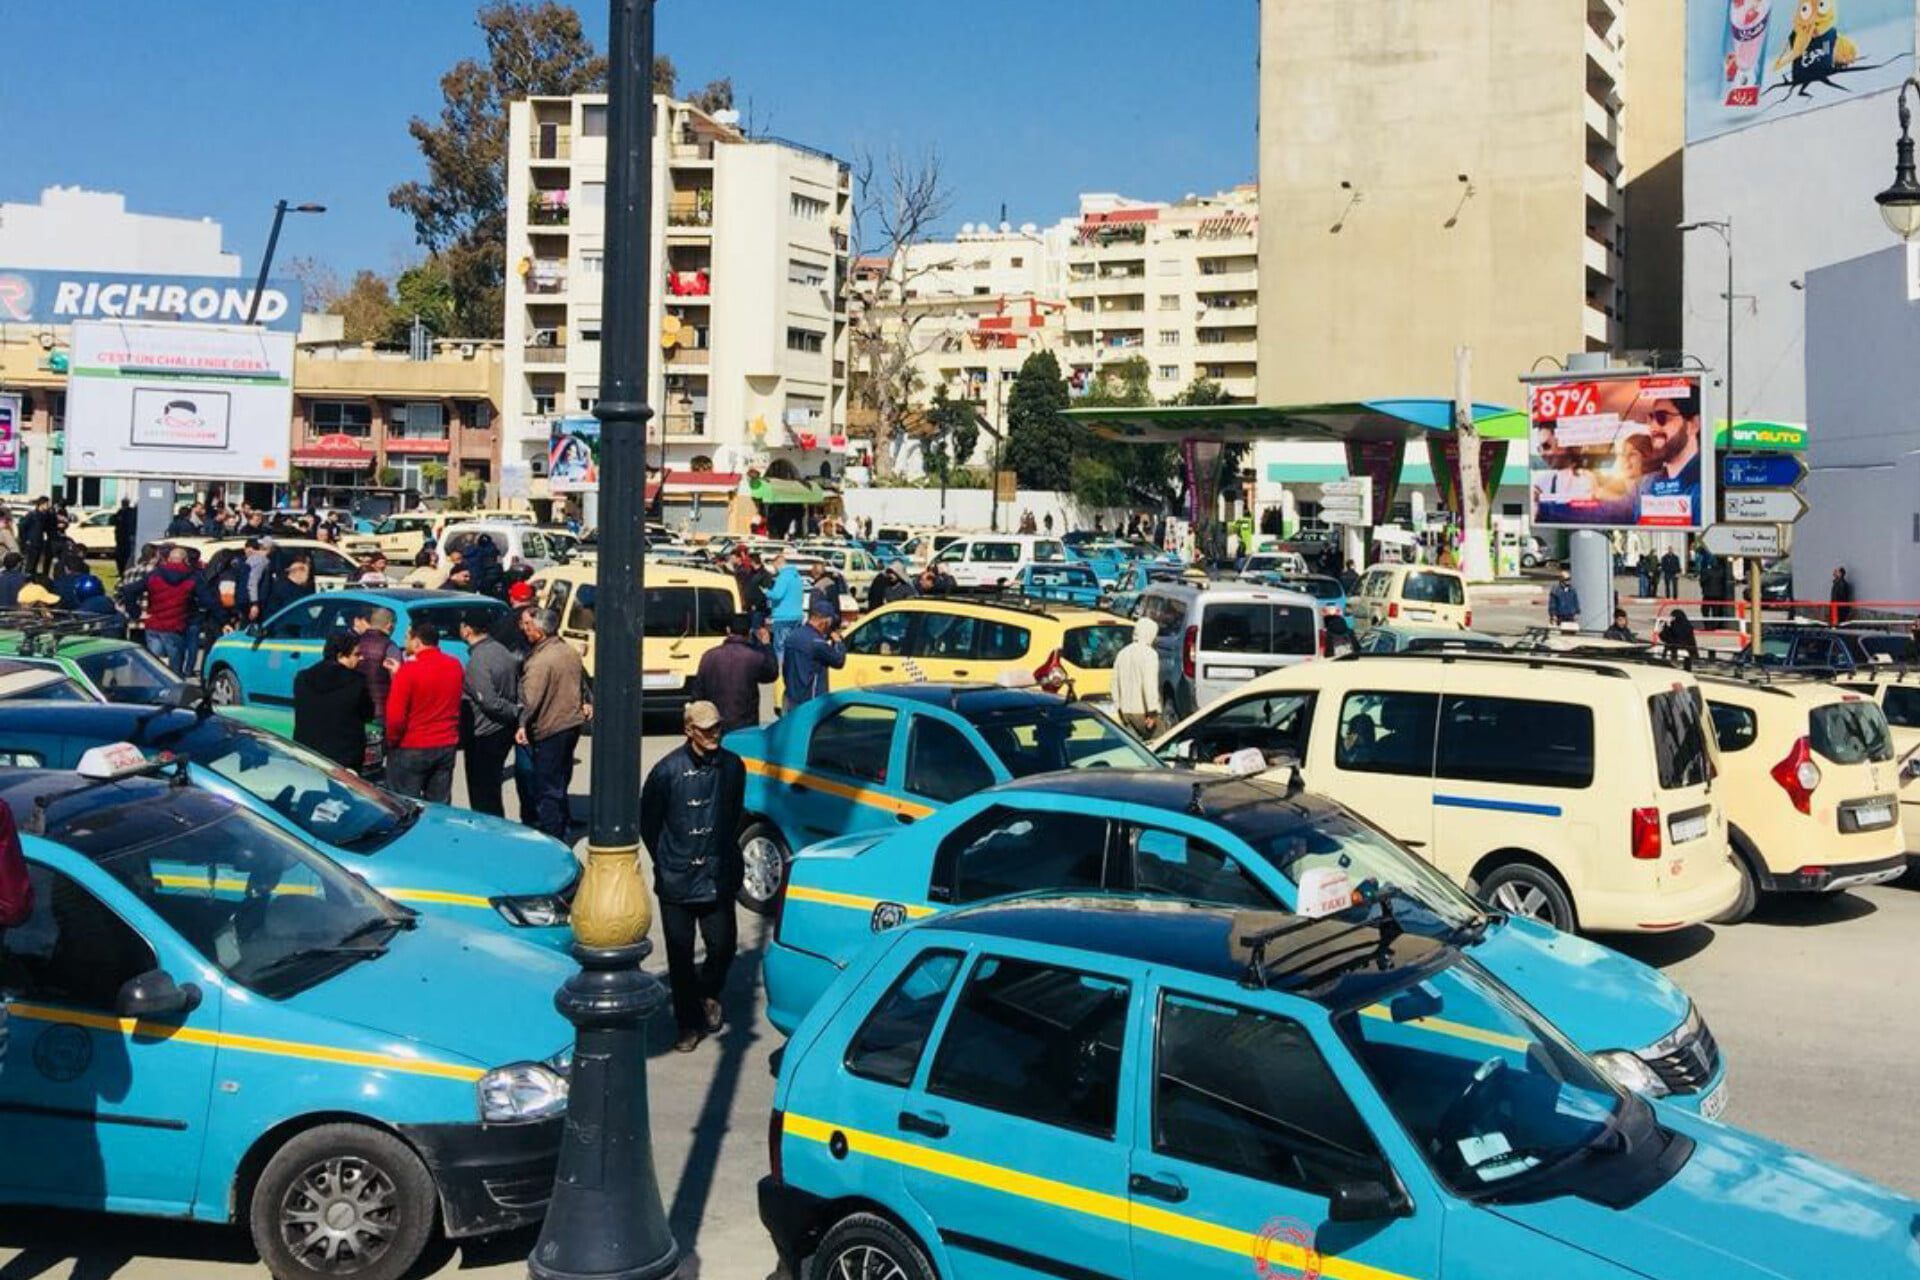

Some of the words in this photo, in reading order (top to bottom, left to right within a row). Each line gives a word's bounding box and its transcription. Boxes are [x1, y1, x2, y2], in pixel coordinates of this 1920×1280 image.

[54, 281, 289, 321] RICHBOND
[136, 354, 153, 364] UN
[1540, 388, 1596, 417] 87%
